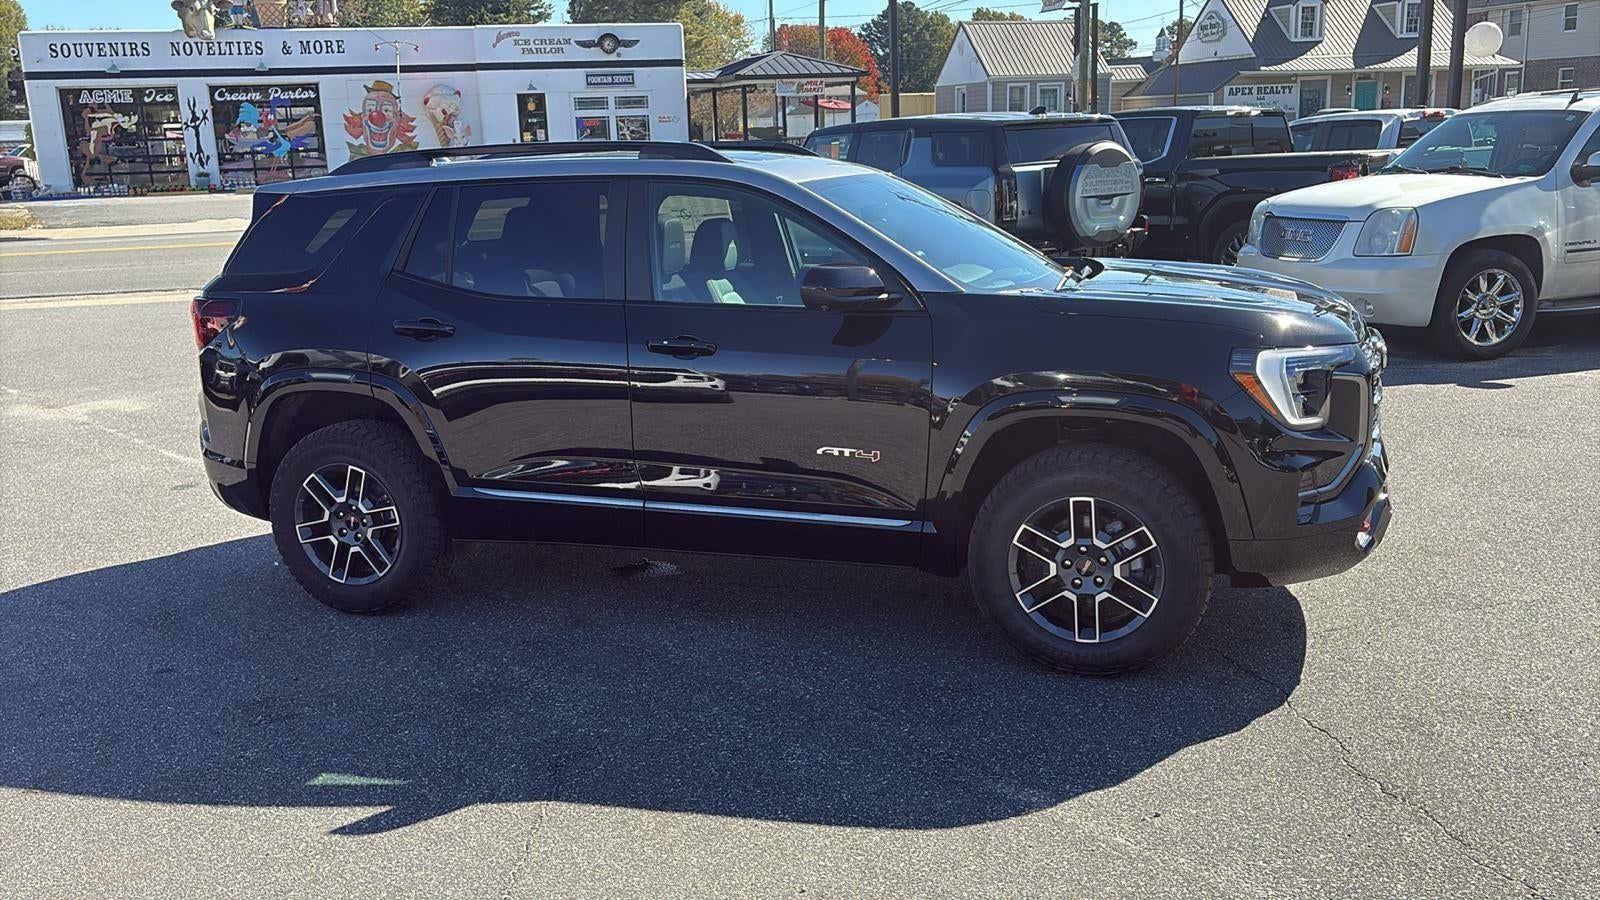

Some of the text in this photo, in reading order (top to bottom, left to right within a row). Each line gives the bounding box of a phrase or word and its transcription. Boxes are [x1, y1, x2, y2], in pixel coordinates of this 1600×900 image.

[48, 40, 346, 58] SOUVENIRS NOVELTIES & MORE
[513, 38, 572, 46] ICE CREAM
[587, 75, 633, 84] FOUNTAIN SERVICE
[79, 89, 175, 103] ACME Ice
[214, 87, 317, 101] Cream Parlor
[1228, 85, 1294, 96] APEX REALTY
[816, 446, 880, 462] AT4
